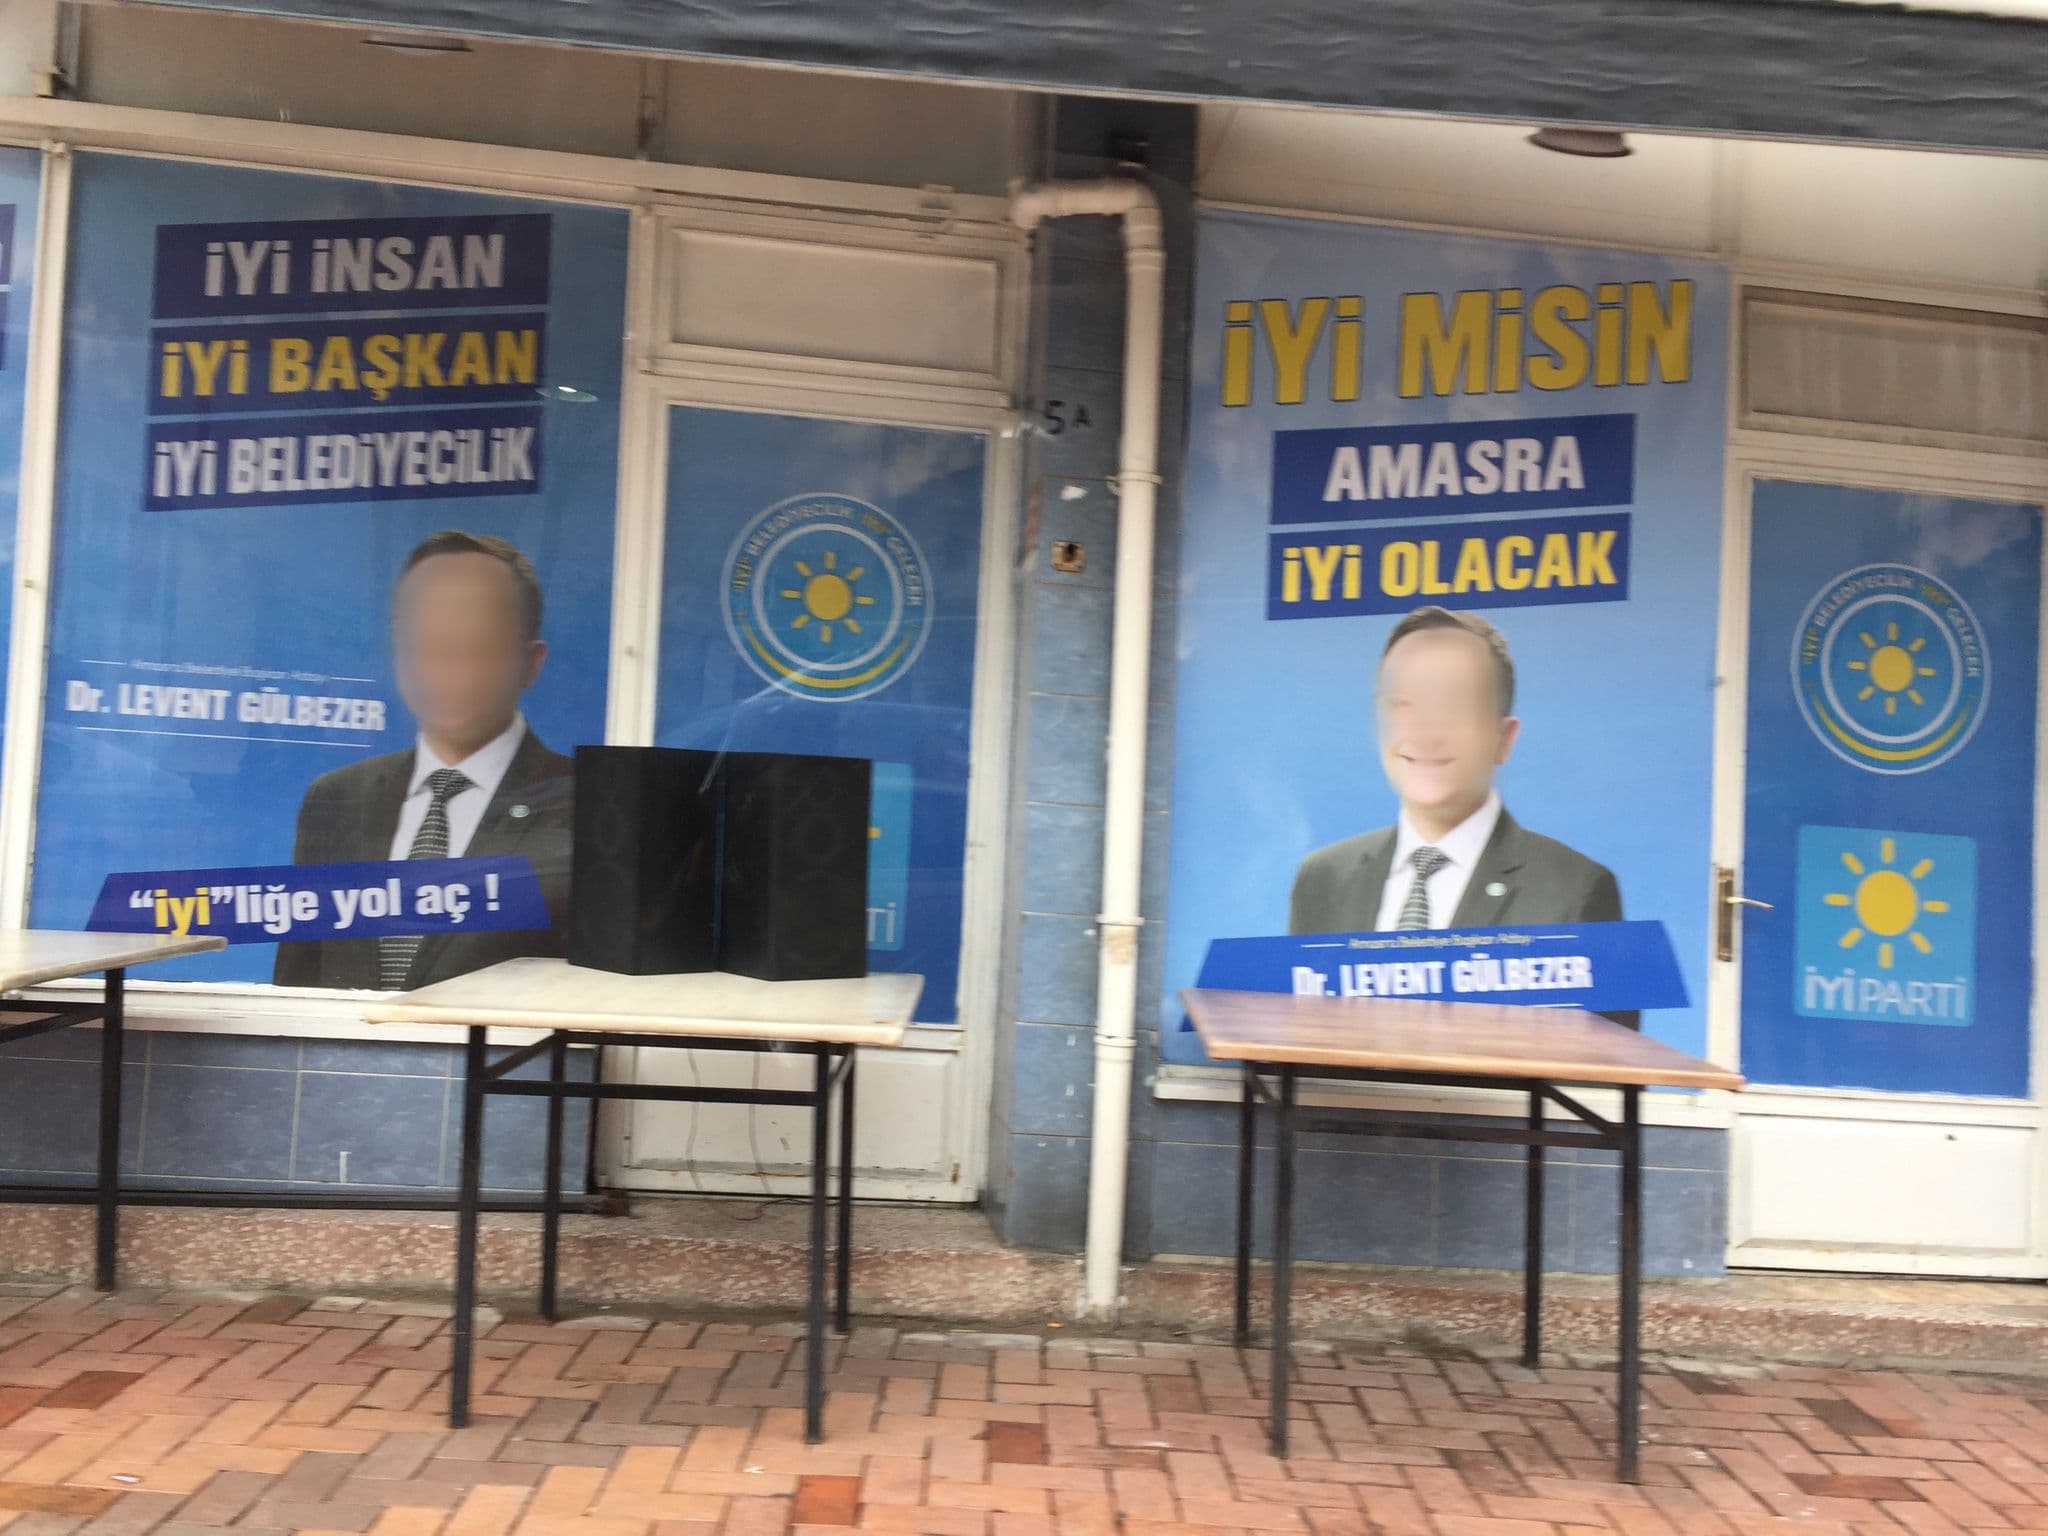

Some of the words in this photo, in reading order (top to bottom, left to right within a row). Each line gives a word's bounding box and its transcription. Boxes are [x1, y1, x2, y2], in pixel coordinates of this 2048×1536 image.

[310, 234, 504, 294] İNSAN
[268, 329, 538, 401] BAŞKAN
[1398, 278, 1694, 399] MİSİN
[226, 427, 536, 495] BELEDİYECİLİK
[1322, 435, 1586, 502] AMASRA
[1379, 530, 1619, 597] OLACAK
[66, 680, 110, 713] Dr.
[117, 683, 231, 721] LEVENT
[237, 686, 386, 731] GÜLBEZER
[331, 877, 401, 930] yol
[414, 882, 471, 924] aç
[1291, 966, 1335, 998] Dr.
[1339, 961, 1446, 997] LEVENT
[1451, 952, 1594, 993] GÜLBEZER
